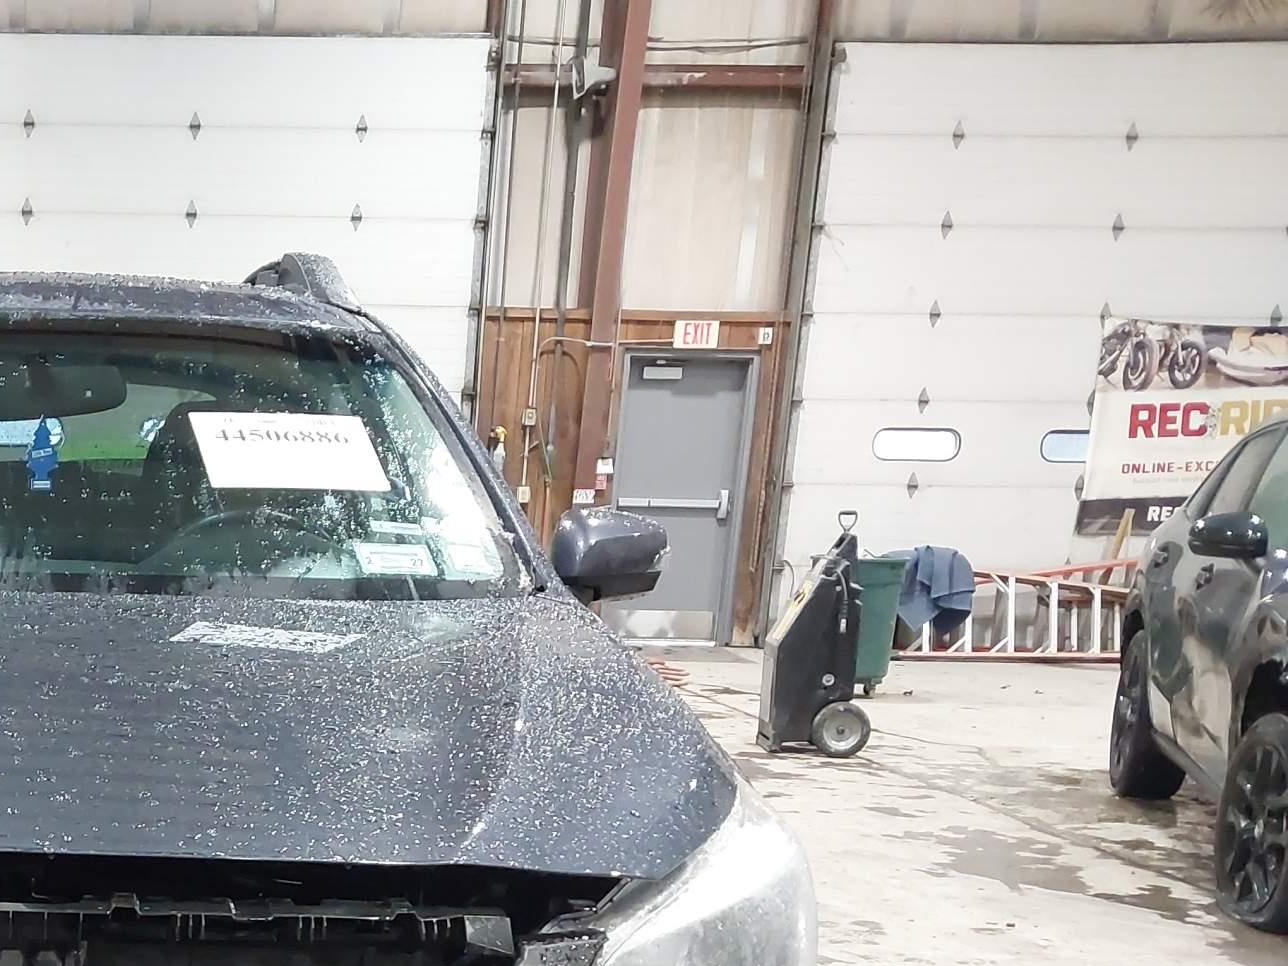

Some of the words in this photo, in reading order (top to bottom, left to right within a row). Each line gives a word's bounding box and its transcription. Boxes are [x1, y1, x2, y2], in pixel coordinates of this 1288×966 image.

[683, 322, 712, 345] EXIT
[1128, 402, 1209, 438] REC
[215, 428, 350, 443] 44506886
[1121, 460, 1220, 474] ONLINE-EXC
[1146, 505, 1180, 522] RE
